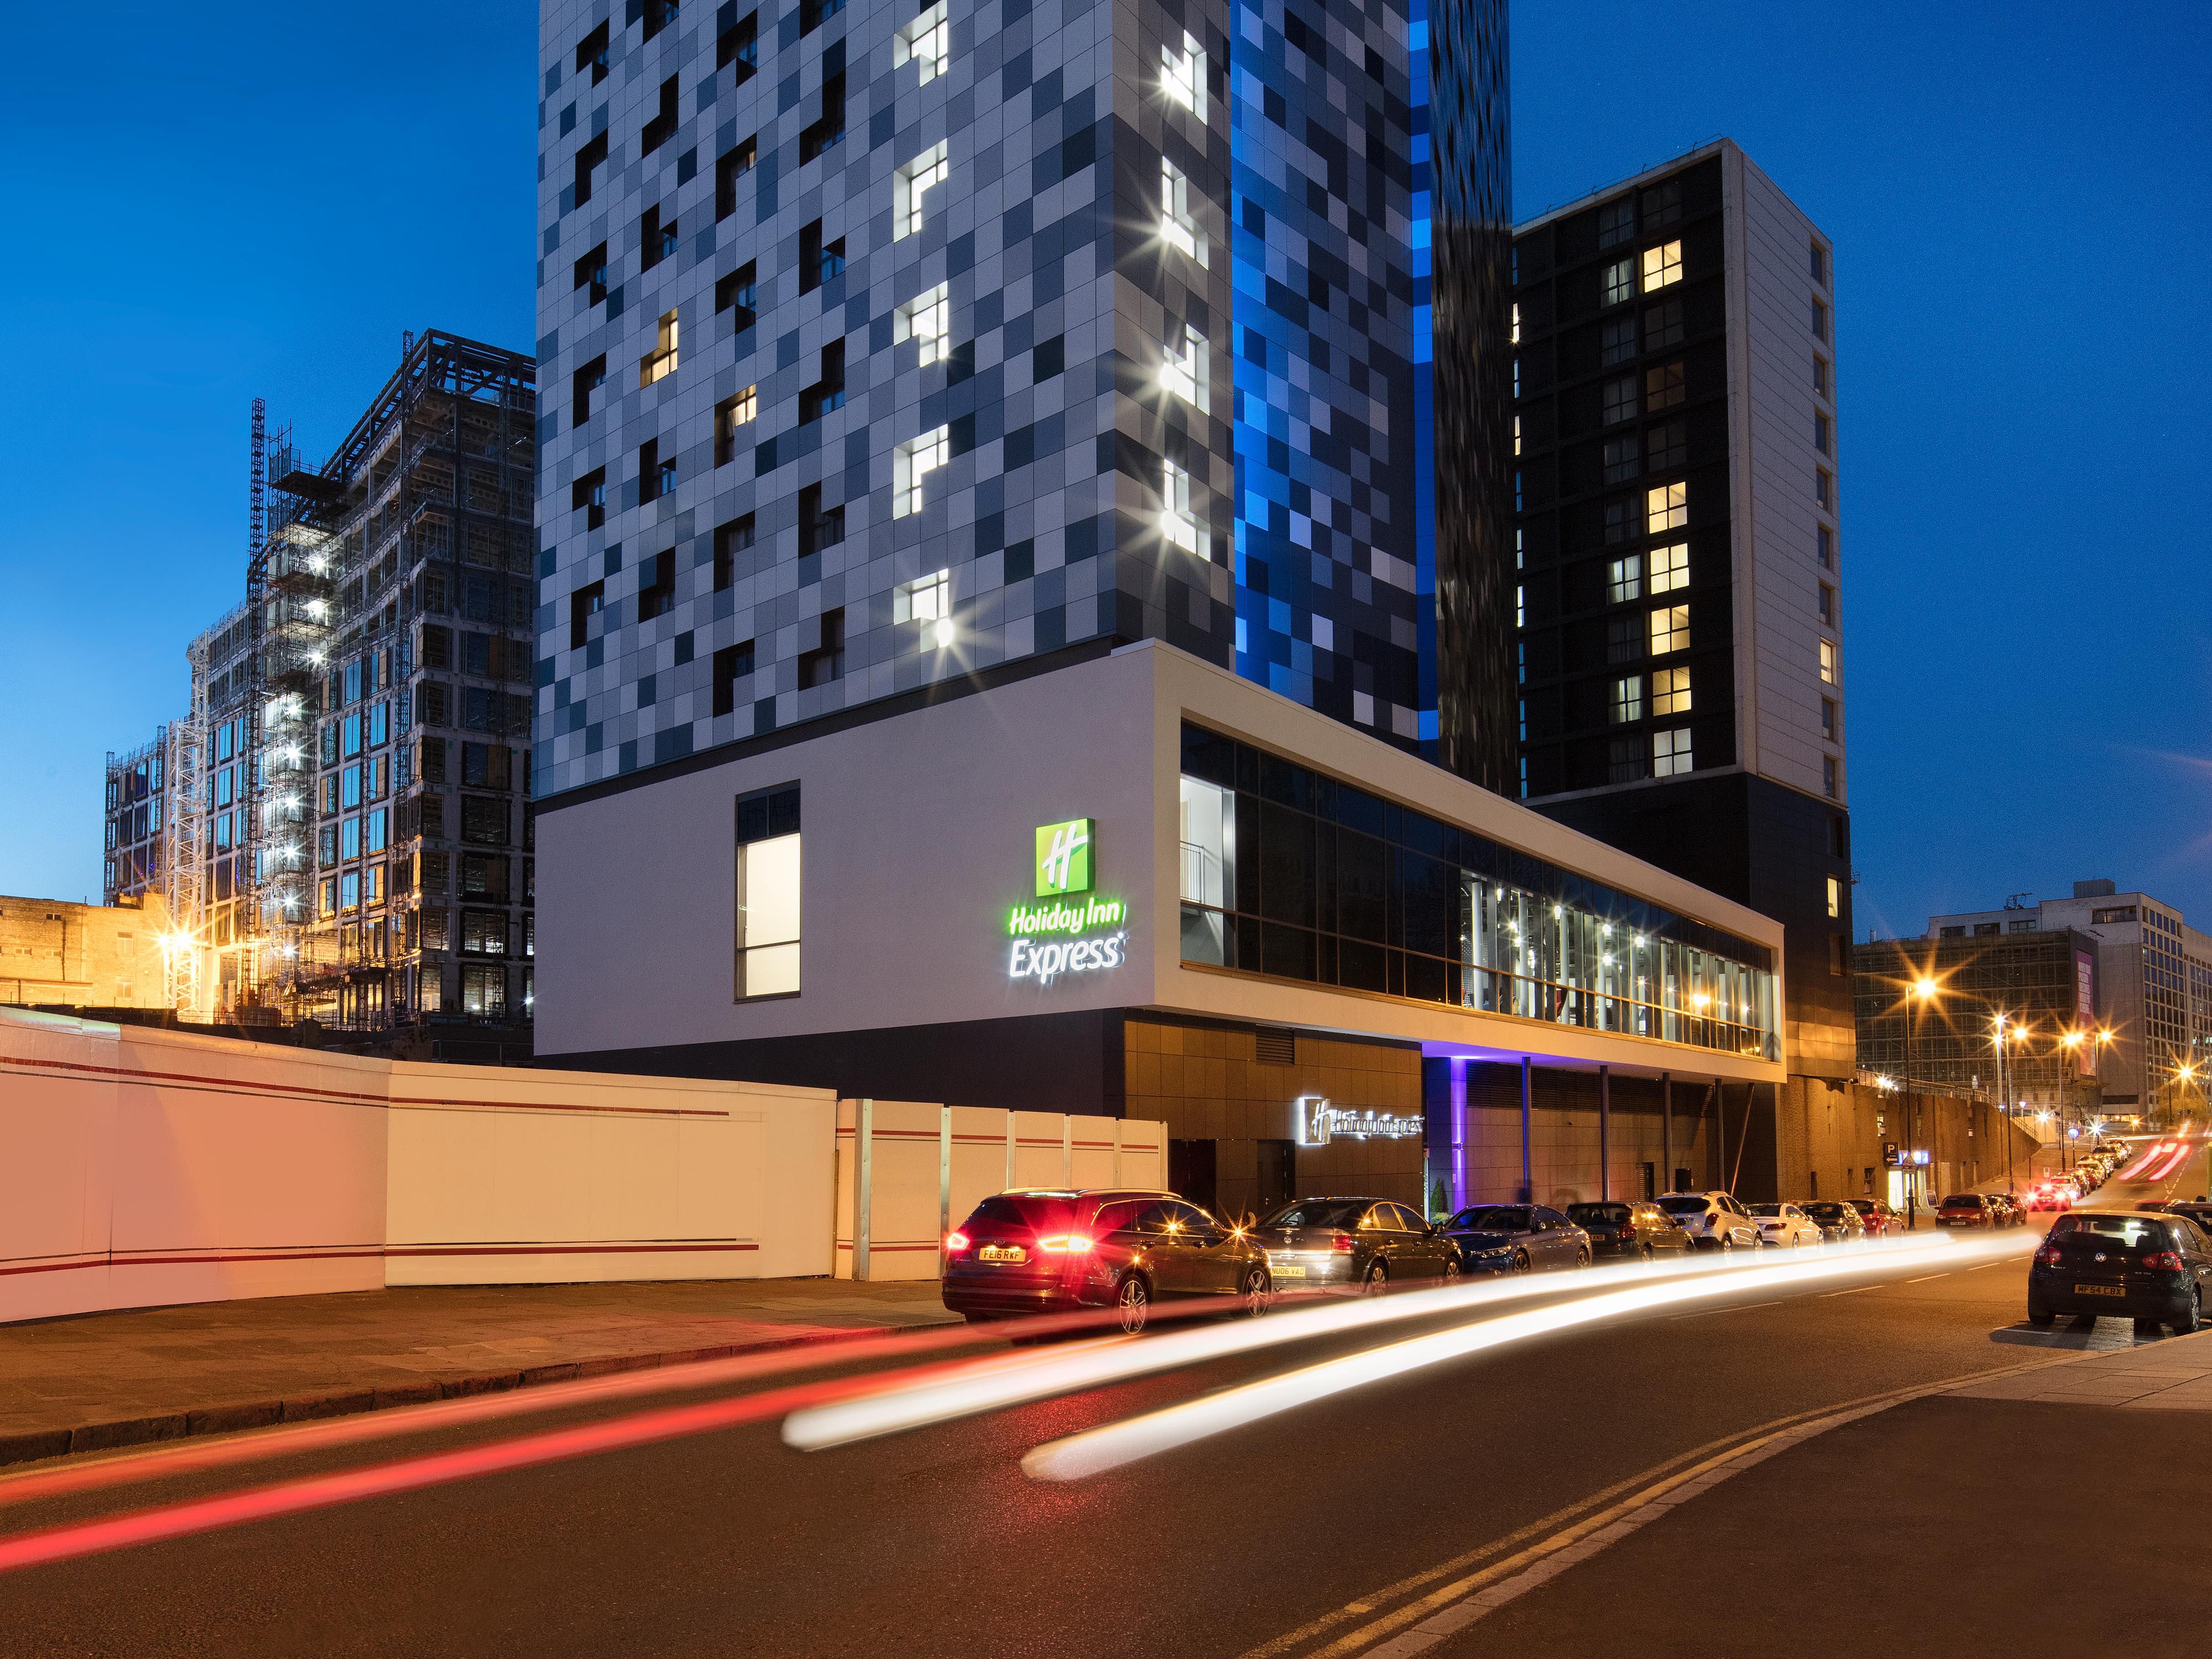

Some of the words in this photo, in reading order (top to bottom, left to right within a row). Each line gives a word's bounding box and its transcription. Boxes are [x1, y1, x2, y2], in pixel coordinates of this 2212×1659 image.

[1010, 903, 1084, 935] Holiday
[1086, 897, 1121, 926] Inn
[1010, 937, 1119, 984] Express
[1887, 1144, 1895, 1154] P
[984, 1250, 1002, 1259] FE16
[1004, 1250, 1021, 1259] RWF
[2078, 1285, 2101, 1294] MF54
[2104, 1287, 2122, 1295] CBX
